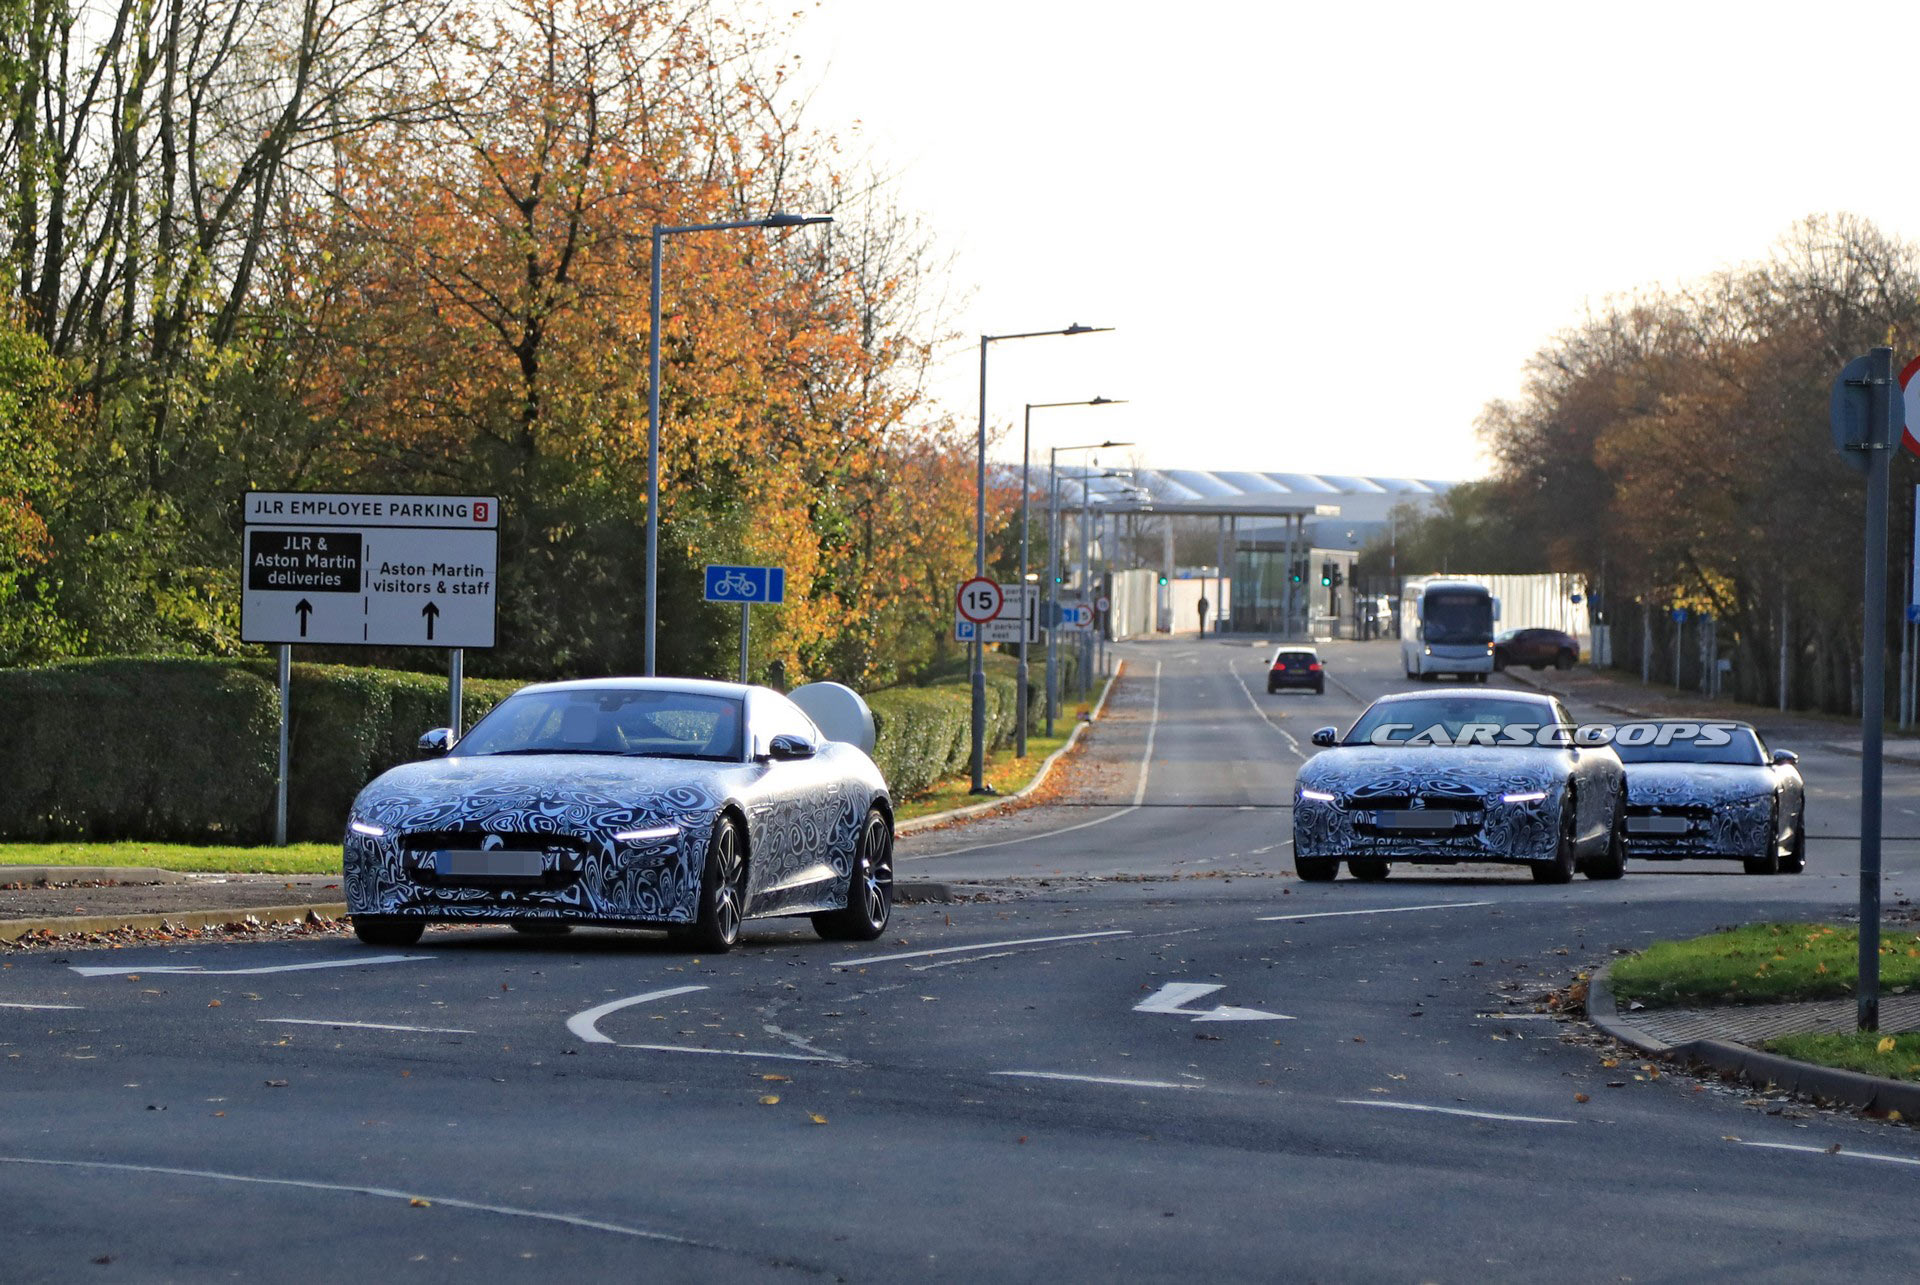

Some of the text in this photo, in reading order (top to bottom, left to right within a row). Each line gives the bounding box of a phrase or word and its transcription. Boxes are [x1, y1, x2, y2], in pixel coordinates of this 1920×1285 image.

[255, 501, 485, 519] JLR EMPLOYEE PARKING 3
[283, 536, 328, 551] JLR &
[254, 553, 356, 569] Aston Martin
[380, 562, 484, 578] Aston Martin
[268, 571, 342, 586] deliveries
[373, 580, 490, 595] visitors & staff
[968, 592, 992, 610] 15
[962, 624, 971, 636] P
